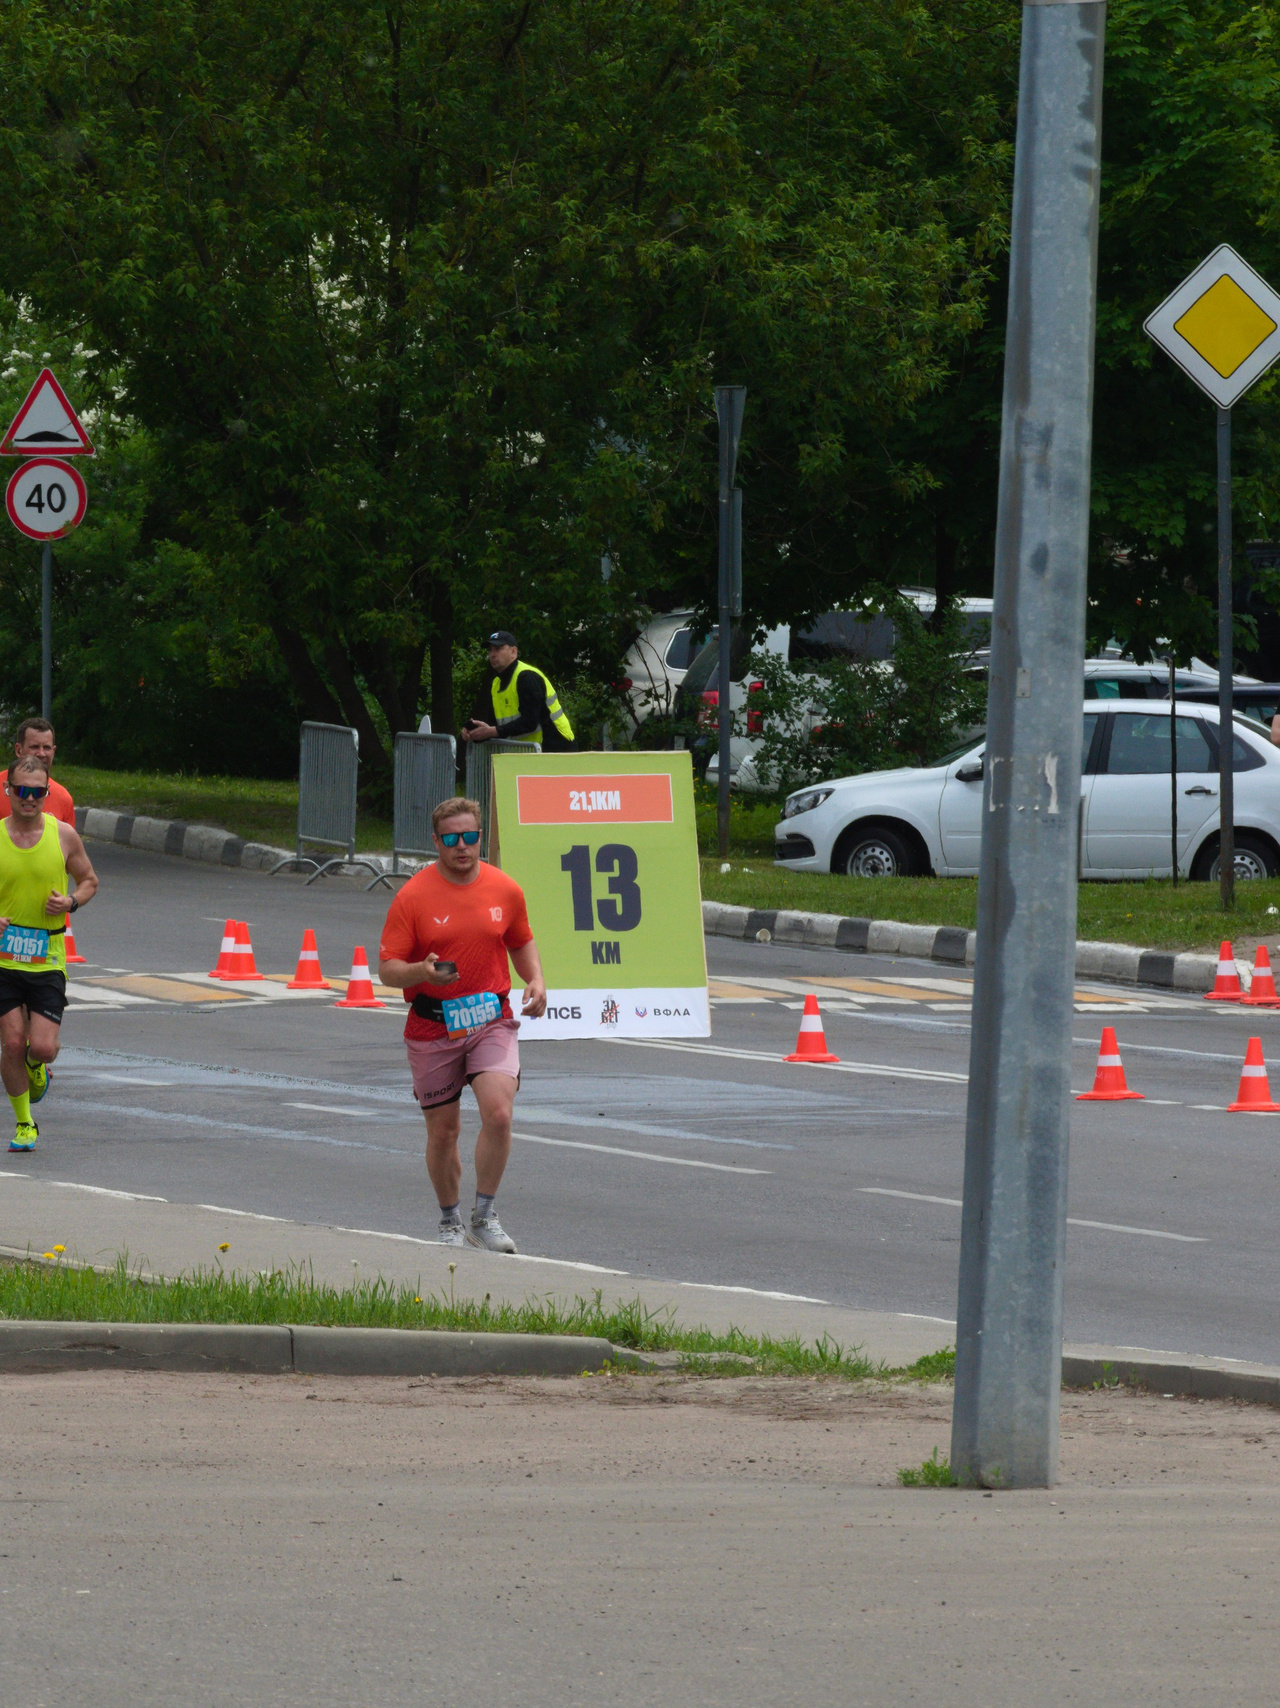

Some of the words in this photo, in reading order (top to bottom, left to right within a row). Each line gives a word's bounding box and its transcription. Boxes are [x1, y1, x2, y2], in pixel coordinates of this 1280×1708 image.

[25, 482, 67, 513] 40
[560, 843, 642, 932] 13
[6, 934, 45, 956] 70151
[591, 941, 622, 965] КМ
[448, 1001, 497, 1029] 70155
[547, 1006, 582, 1020] ПСБ
[653, 1008, 691, 1017] ВФЛА
